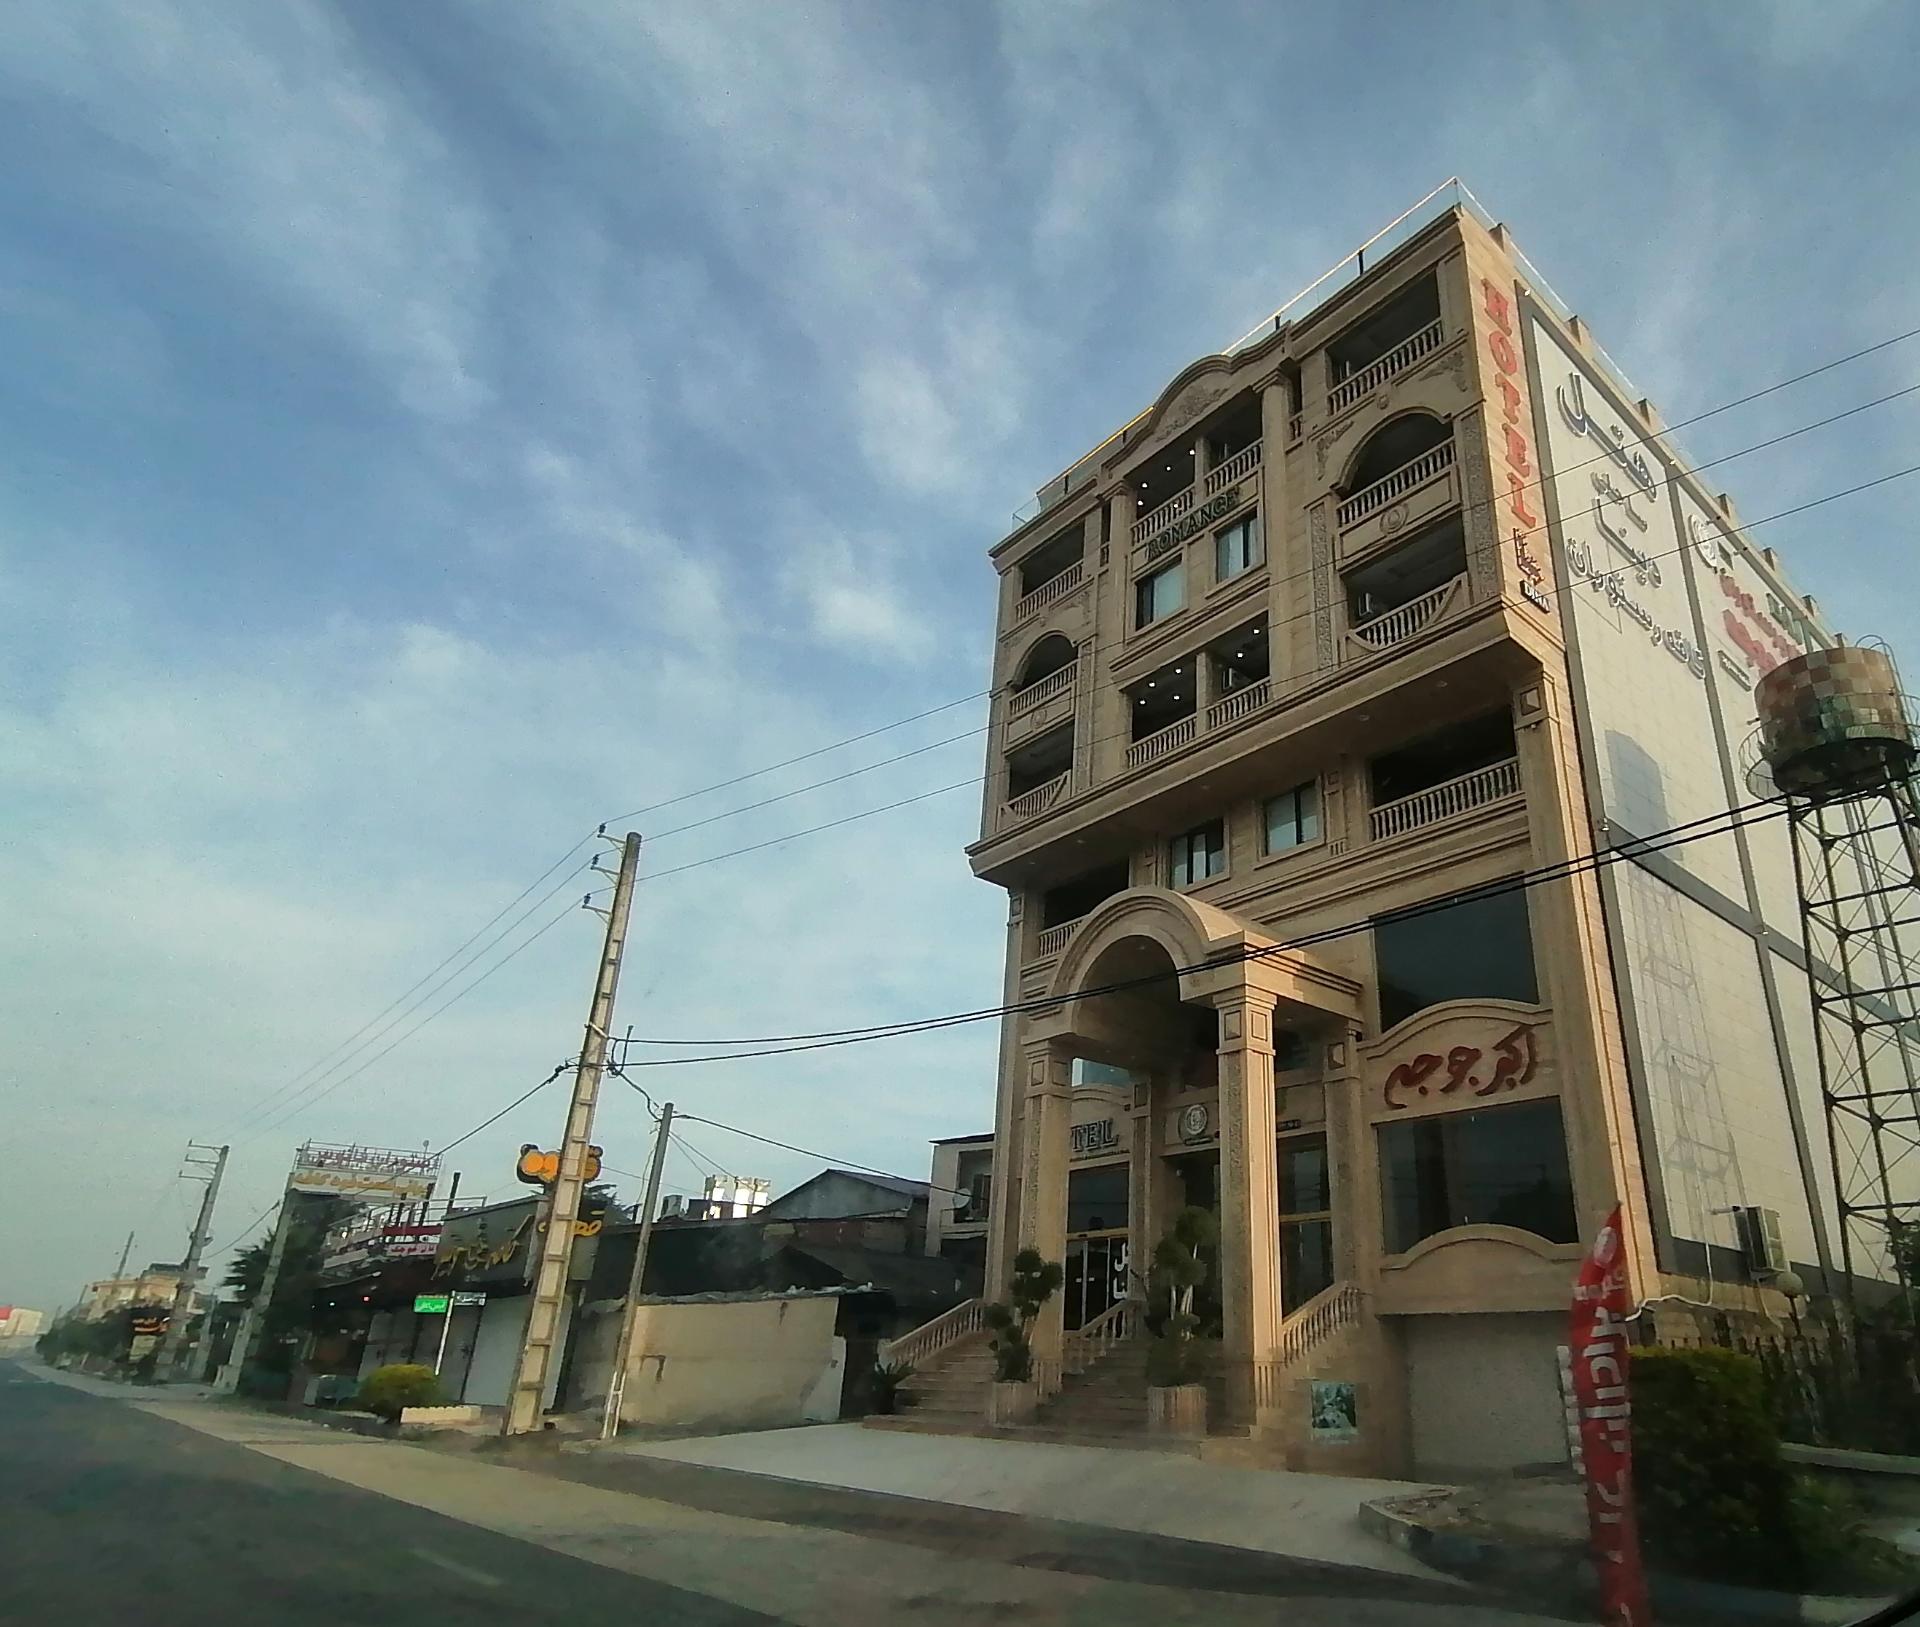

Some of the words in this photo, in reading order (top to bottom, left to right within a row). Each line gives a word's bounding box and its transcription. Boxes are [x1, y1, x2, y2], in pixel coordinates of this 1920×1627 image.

[1481, 278, 1537, 529] HOTEL
[1557, 373, 1657, 502] هتل
[1592, 498, 1662, 588] دینا
[1567, 538, 1663, 646] رستوران
[1384, 1046, 1484, 1109] جوجه
[1475, 1024, 1538, 1098] اکبر
[1071, 1119, 1119, 1152] TEL
